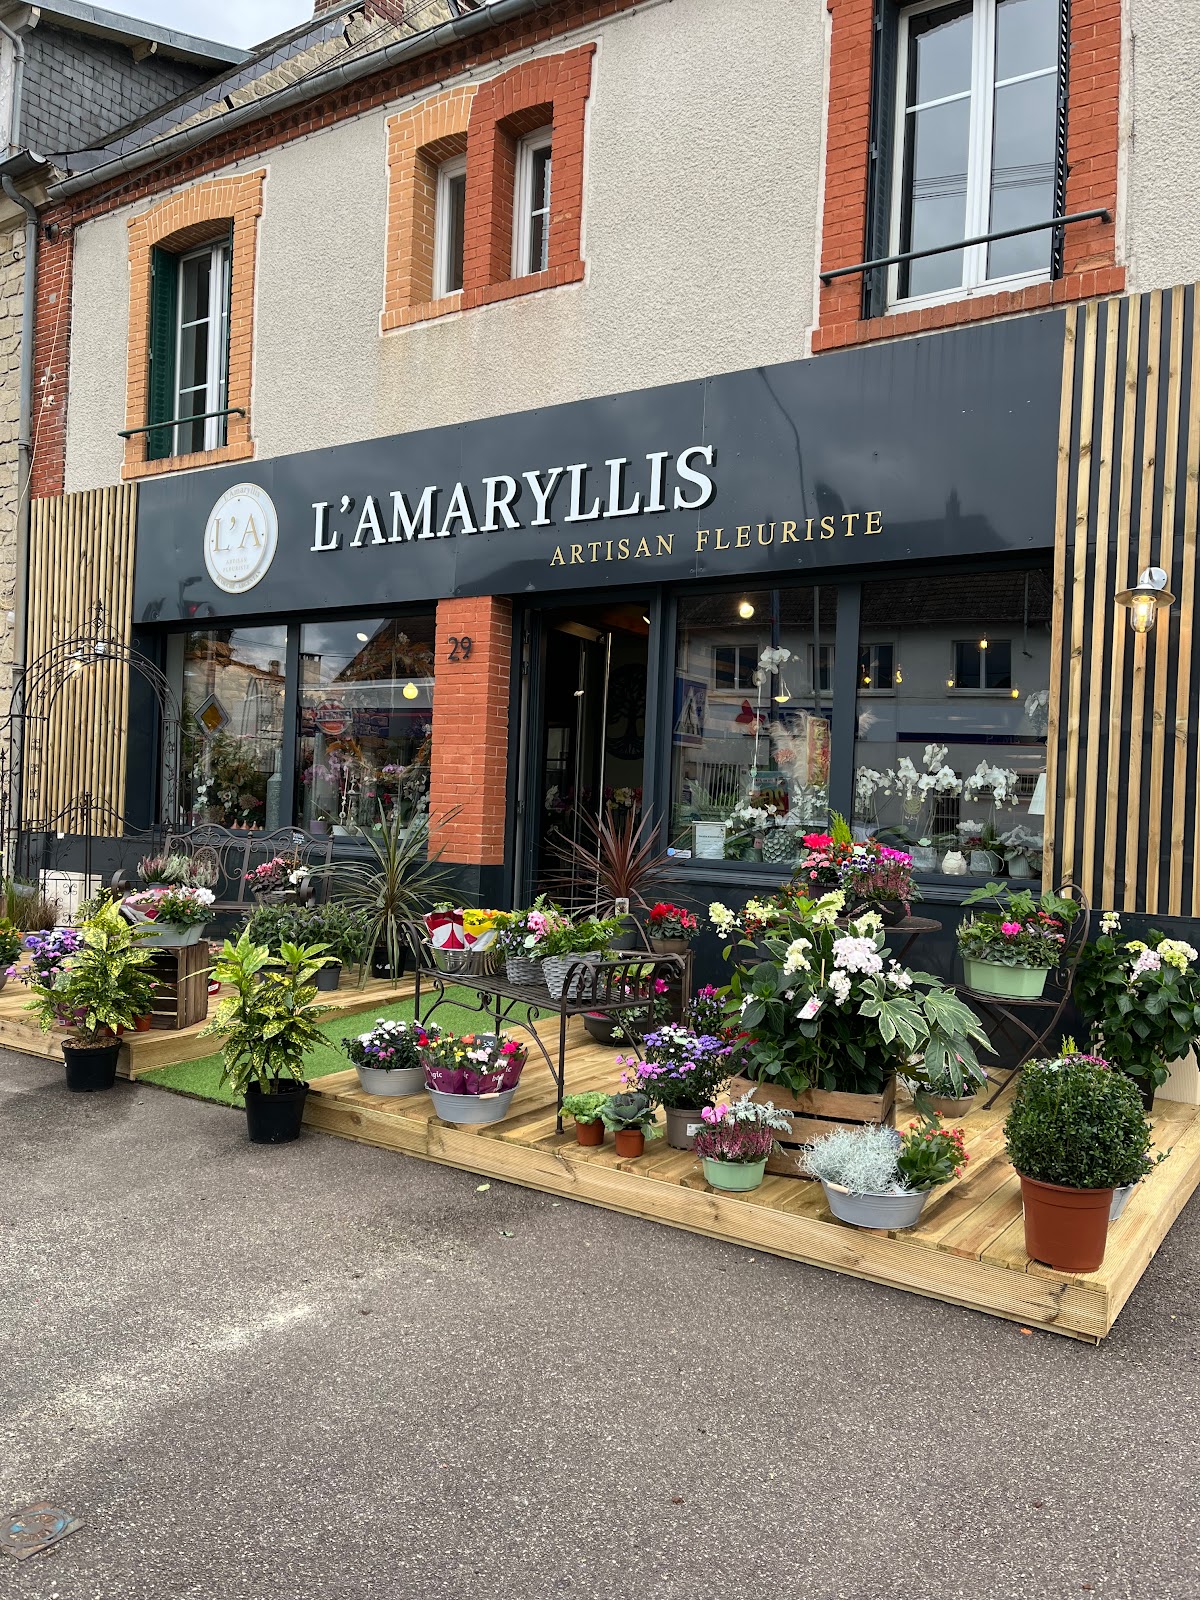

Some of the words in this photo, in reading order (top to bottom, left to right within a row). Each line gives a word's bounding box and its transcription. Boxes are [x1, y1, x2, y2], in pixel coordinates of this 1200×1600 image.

[310, 445, 715, 552] L'AMARYLLIS
[213, 513, 261, 552] L'A
[549, 533, 676, 567] ARTISAN
[694, 510, 884, 552] FLEURISTE
[447, 636, 473, 661] 29
